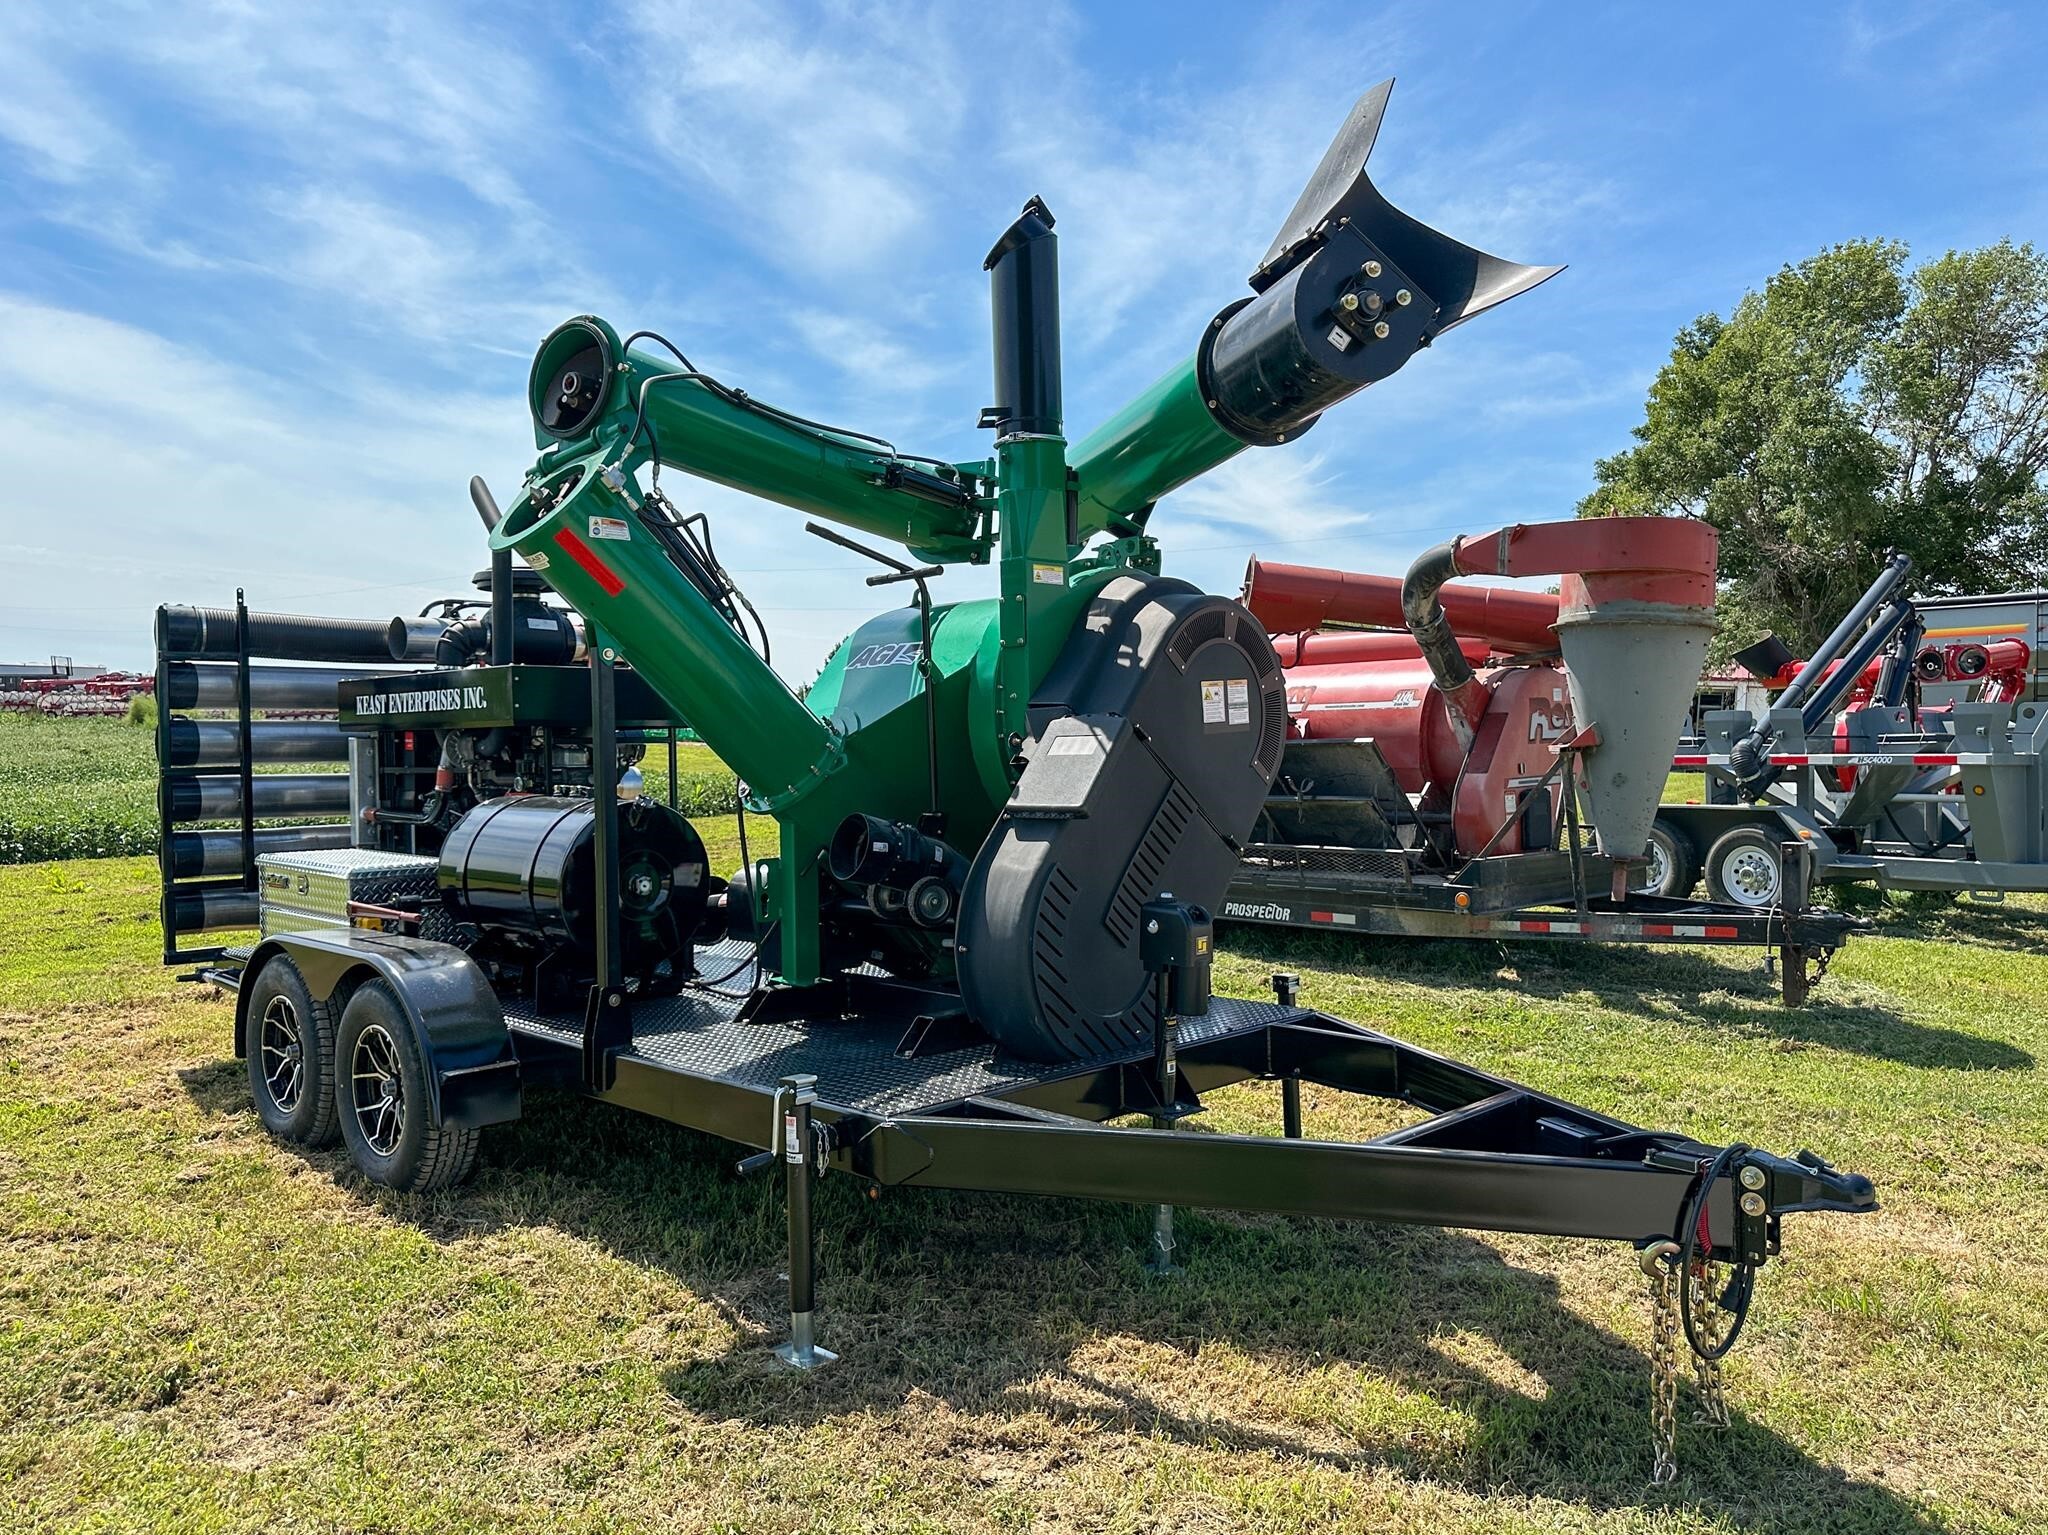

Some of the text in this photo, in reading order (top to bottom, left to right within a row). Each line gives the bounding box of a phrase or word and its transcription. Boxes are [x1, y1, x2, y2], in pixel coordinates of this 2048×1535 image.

[843, 642, 919, 670] AGI
[356, 686, 487, 715] KEAST ENTERPRISES INC.
[1225, 902, 1291, 921] PROSPECTOR
